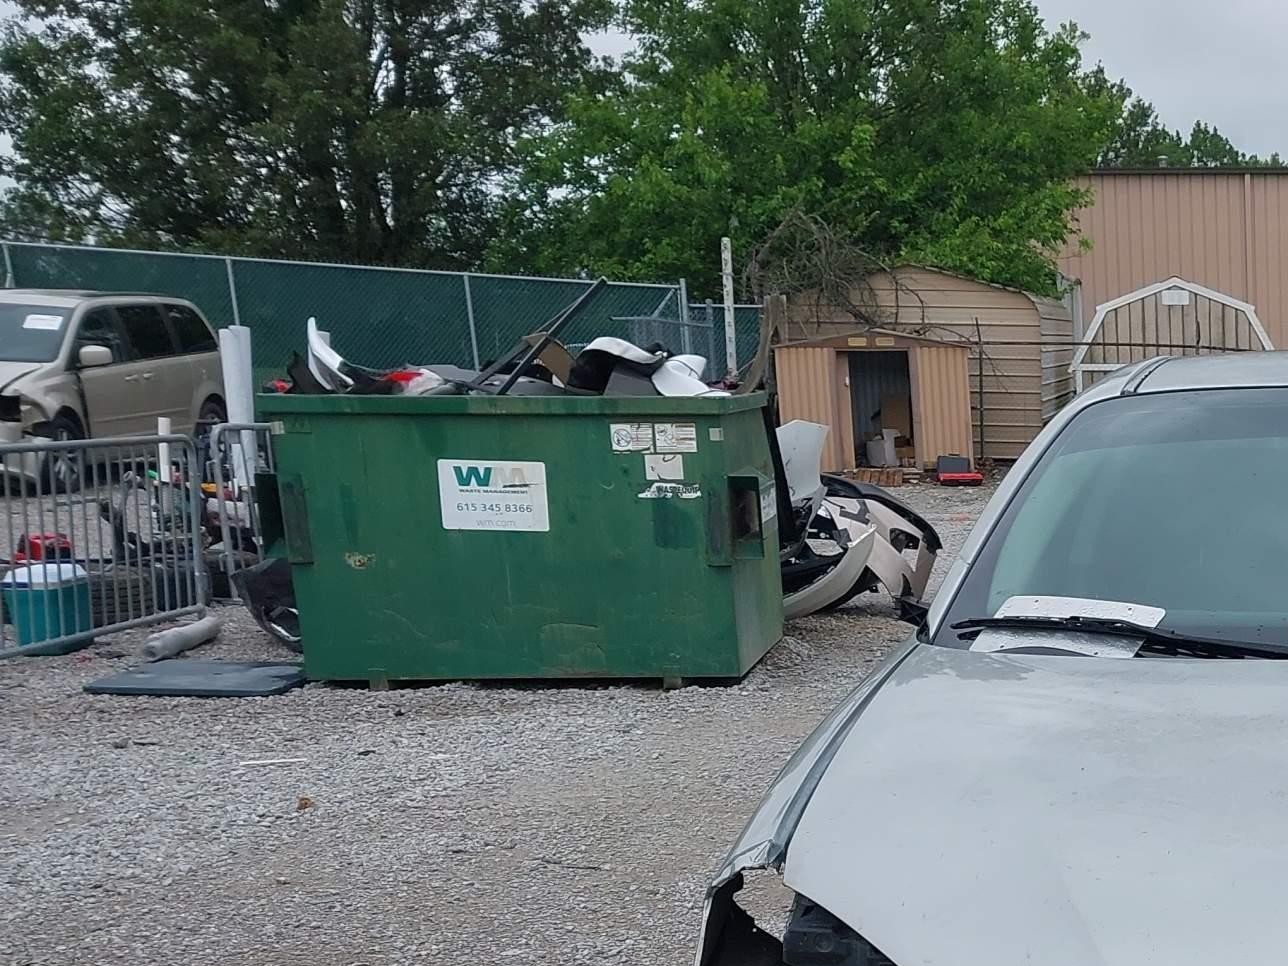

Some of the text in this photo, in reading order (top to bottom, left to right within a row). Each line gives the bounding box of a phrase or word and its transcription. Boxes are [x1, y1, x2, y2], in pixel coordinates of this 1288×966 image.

[457, 503, 533, 513] 615 345 8366
[476, 519, 517, 527] wm.com
